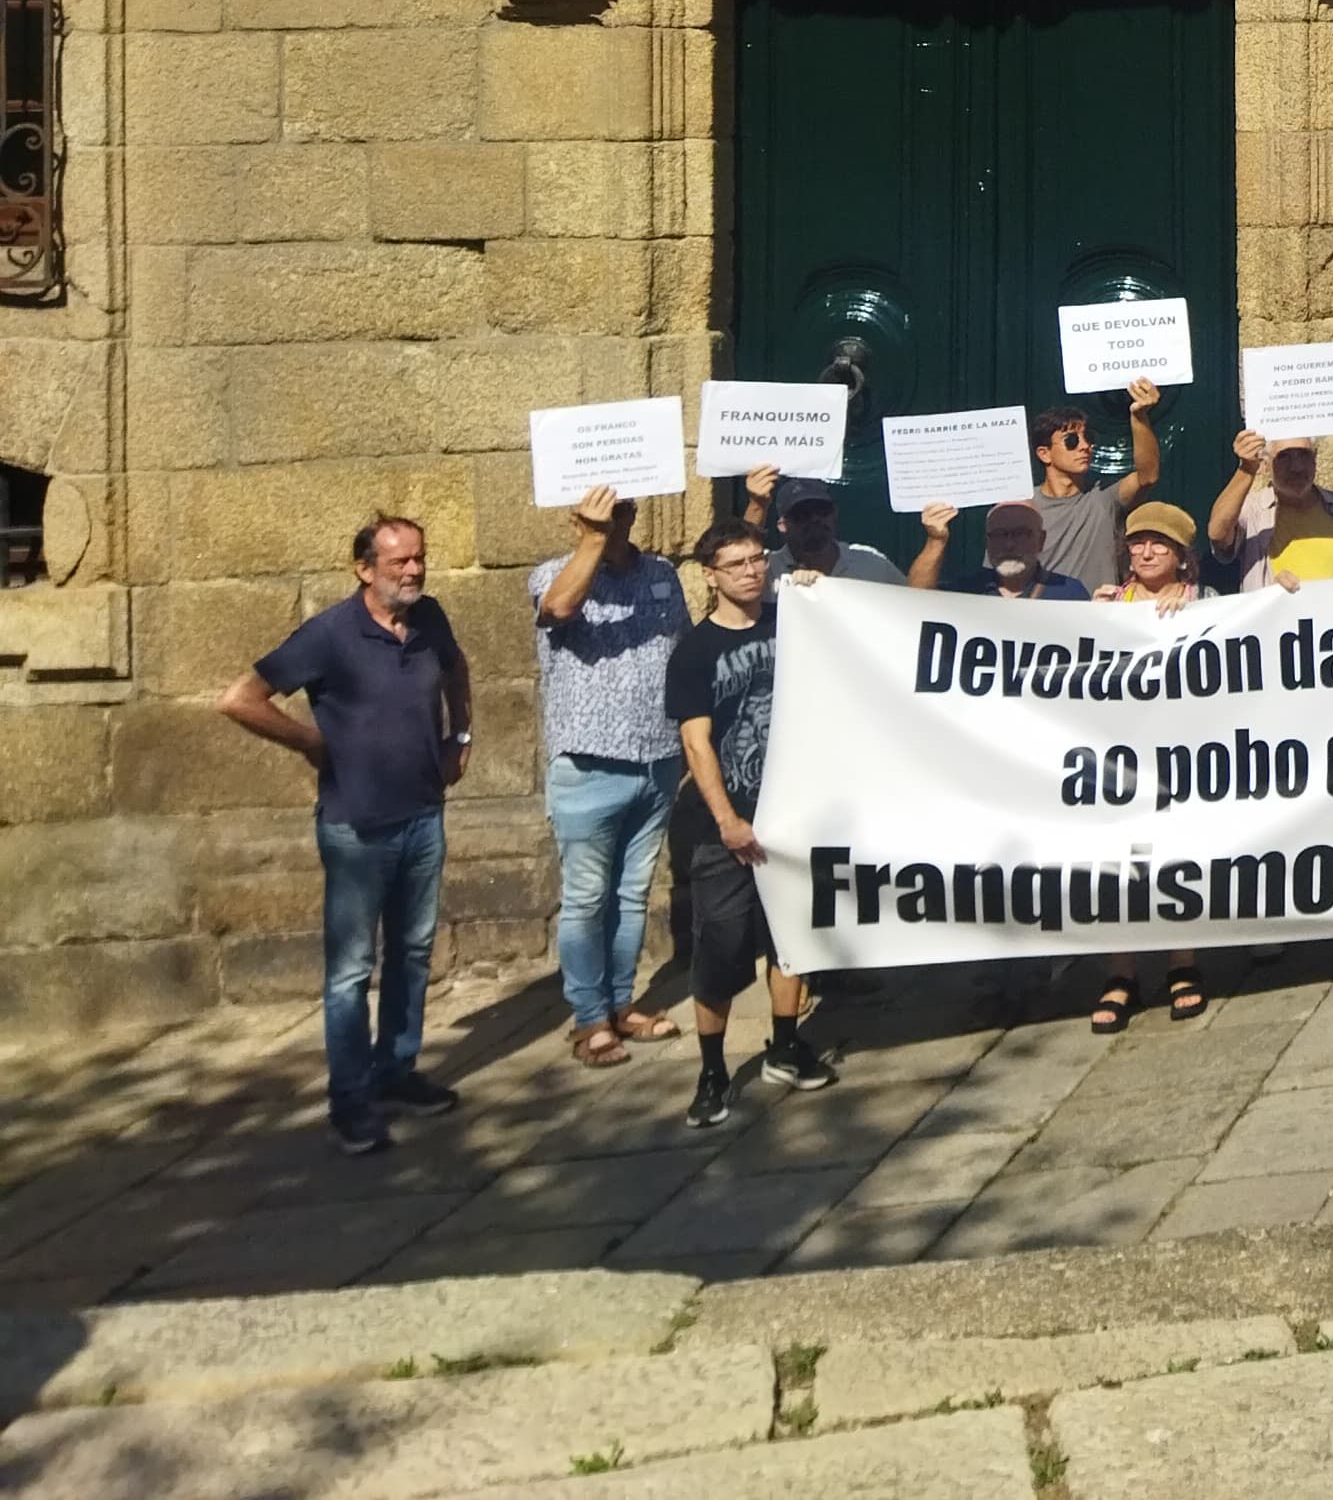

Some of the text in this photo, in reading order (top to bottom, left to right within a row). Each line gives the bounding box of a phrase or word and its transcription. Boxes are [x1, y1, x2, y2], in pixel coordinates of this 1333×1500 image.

[1071, 316, 1176, 332] QUE DEVOLVAN
[1108, 338, 1145, 350] TODO
[1088, 357, 1168, 372] O ROUBADO
[1273, 364, 1294, 372] NON
[1282, 377, 1313, 386] PEDRO
[720, 410, 831, 423] FRANQUISMO
[577, 420, 637, 434] OS FRANCO
[891, 428, 921, 436] PEDRO
[991, 418, 1017, 428] MAZA
[572, 435, 644, 450] SON PERSOAS
[720, 435, 778, 446] NUNCA
[575, 451, 643, 465] NON GRATAS
[914, 620, 1263, 701] Devolución
[1061, 743, 1138, 806] ao
[1155, 728, 1309, 813] pobo
